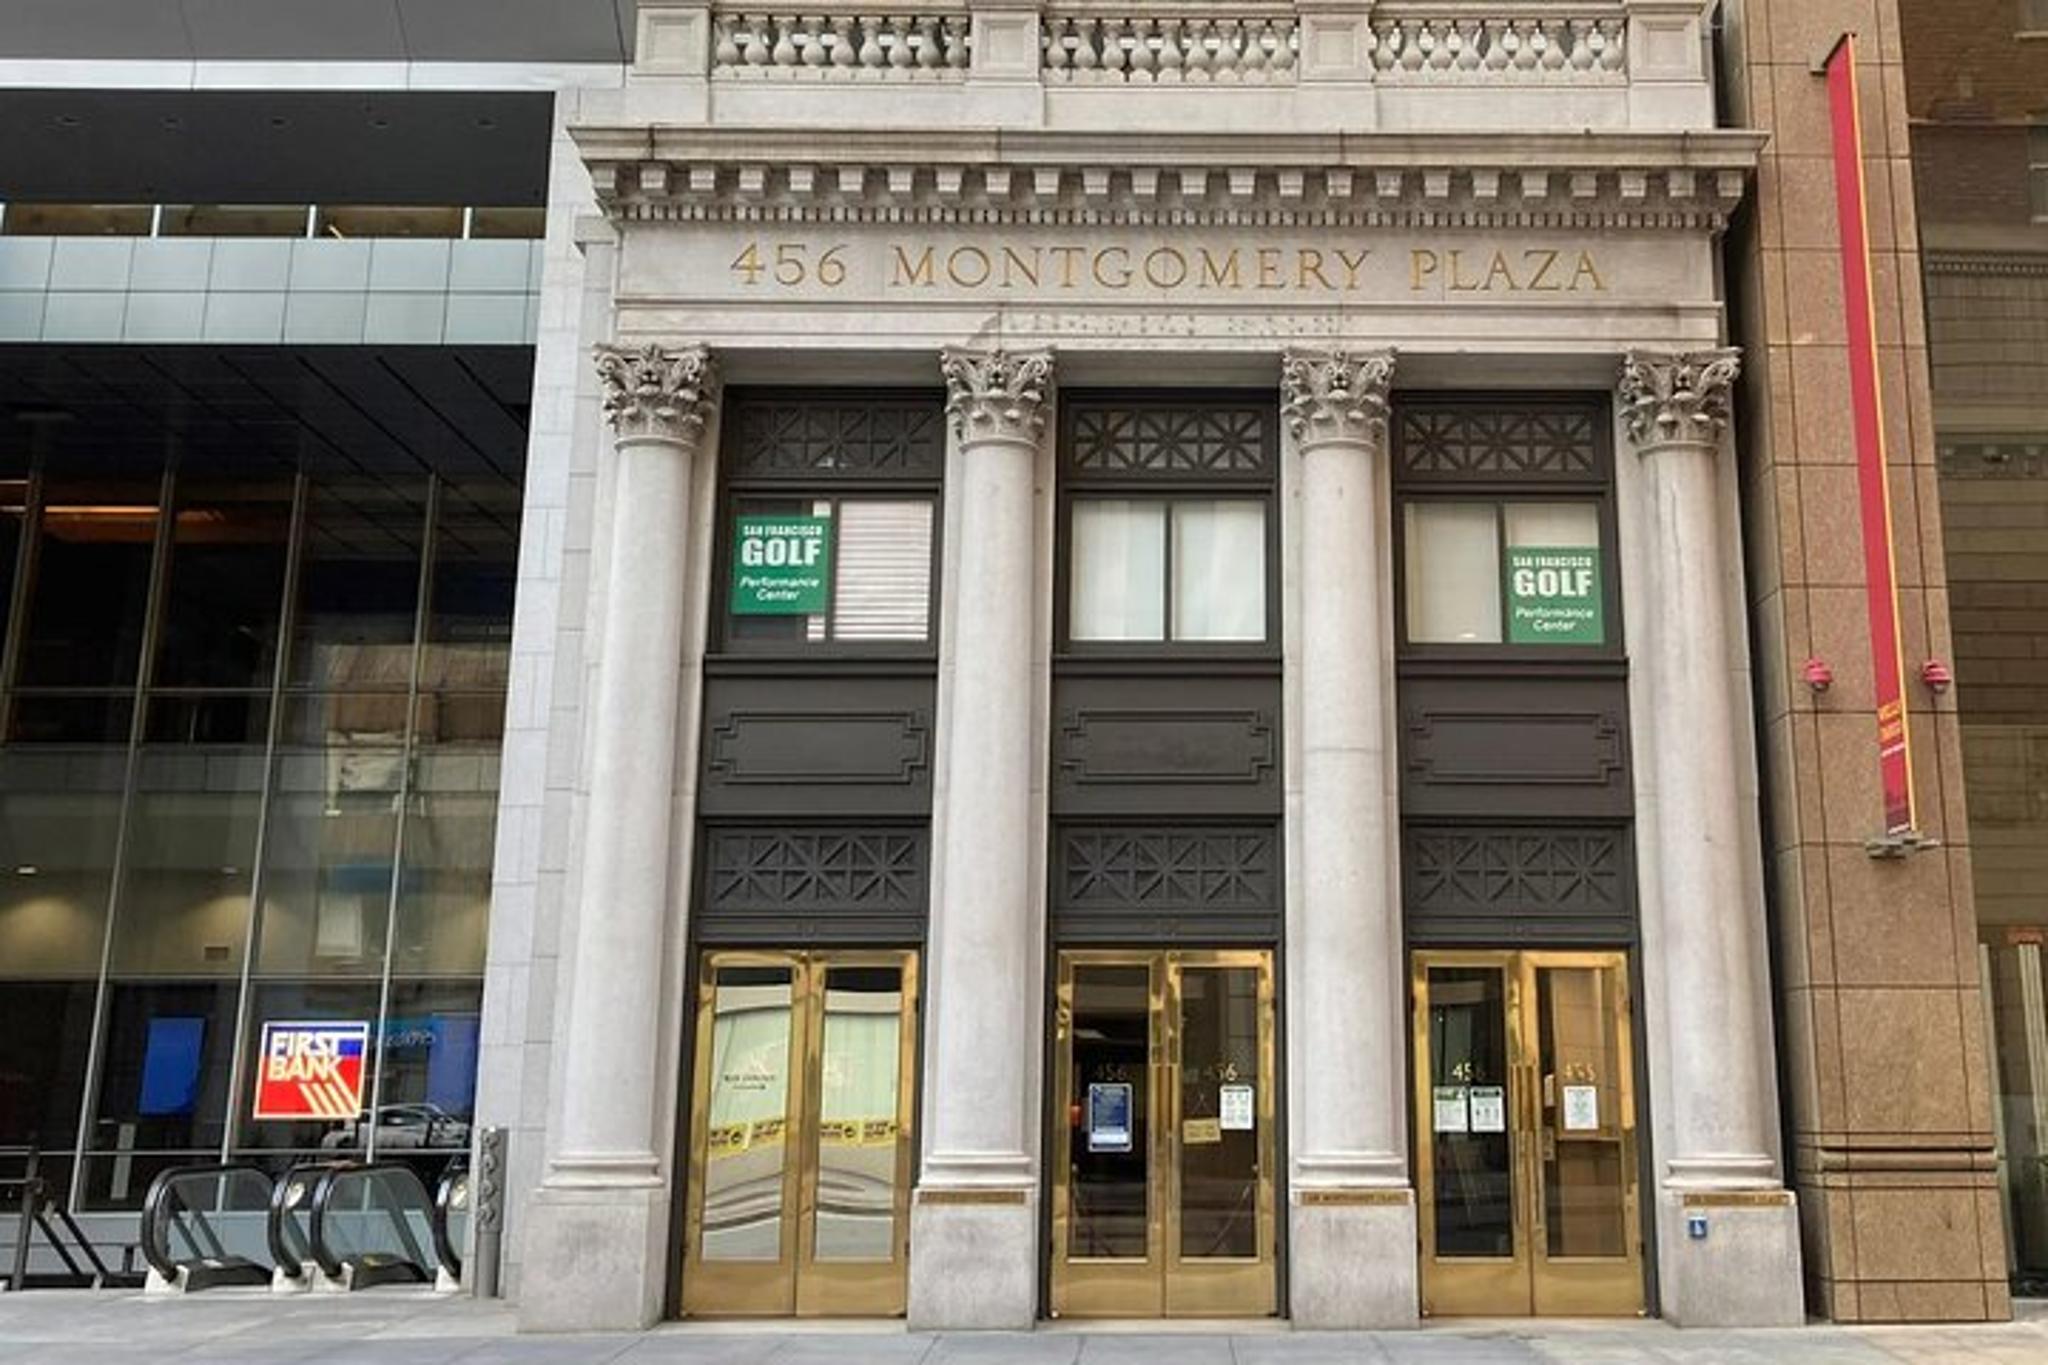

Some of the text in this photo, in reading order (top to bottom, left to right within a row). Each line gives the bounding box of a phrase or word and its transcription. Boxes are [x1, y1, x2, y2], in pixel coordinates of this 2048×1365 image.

[730, 241, 1607, 292] 456 MONTGOMERY PLAZA
[741, 537, 822, 567] GOLF
[740, 576, 819, 589] Performance
[756, 588, 799, 601] Center
[1514, 569, 1593, 597] GOLF
[1515, 606, 1594, 619] Performance
[1533, 619, 1577, 632] Center
[269, 1031, 350, 1057] FIRST
[267, 1055, 344, 1084] BANK
